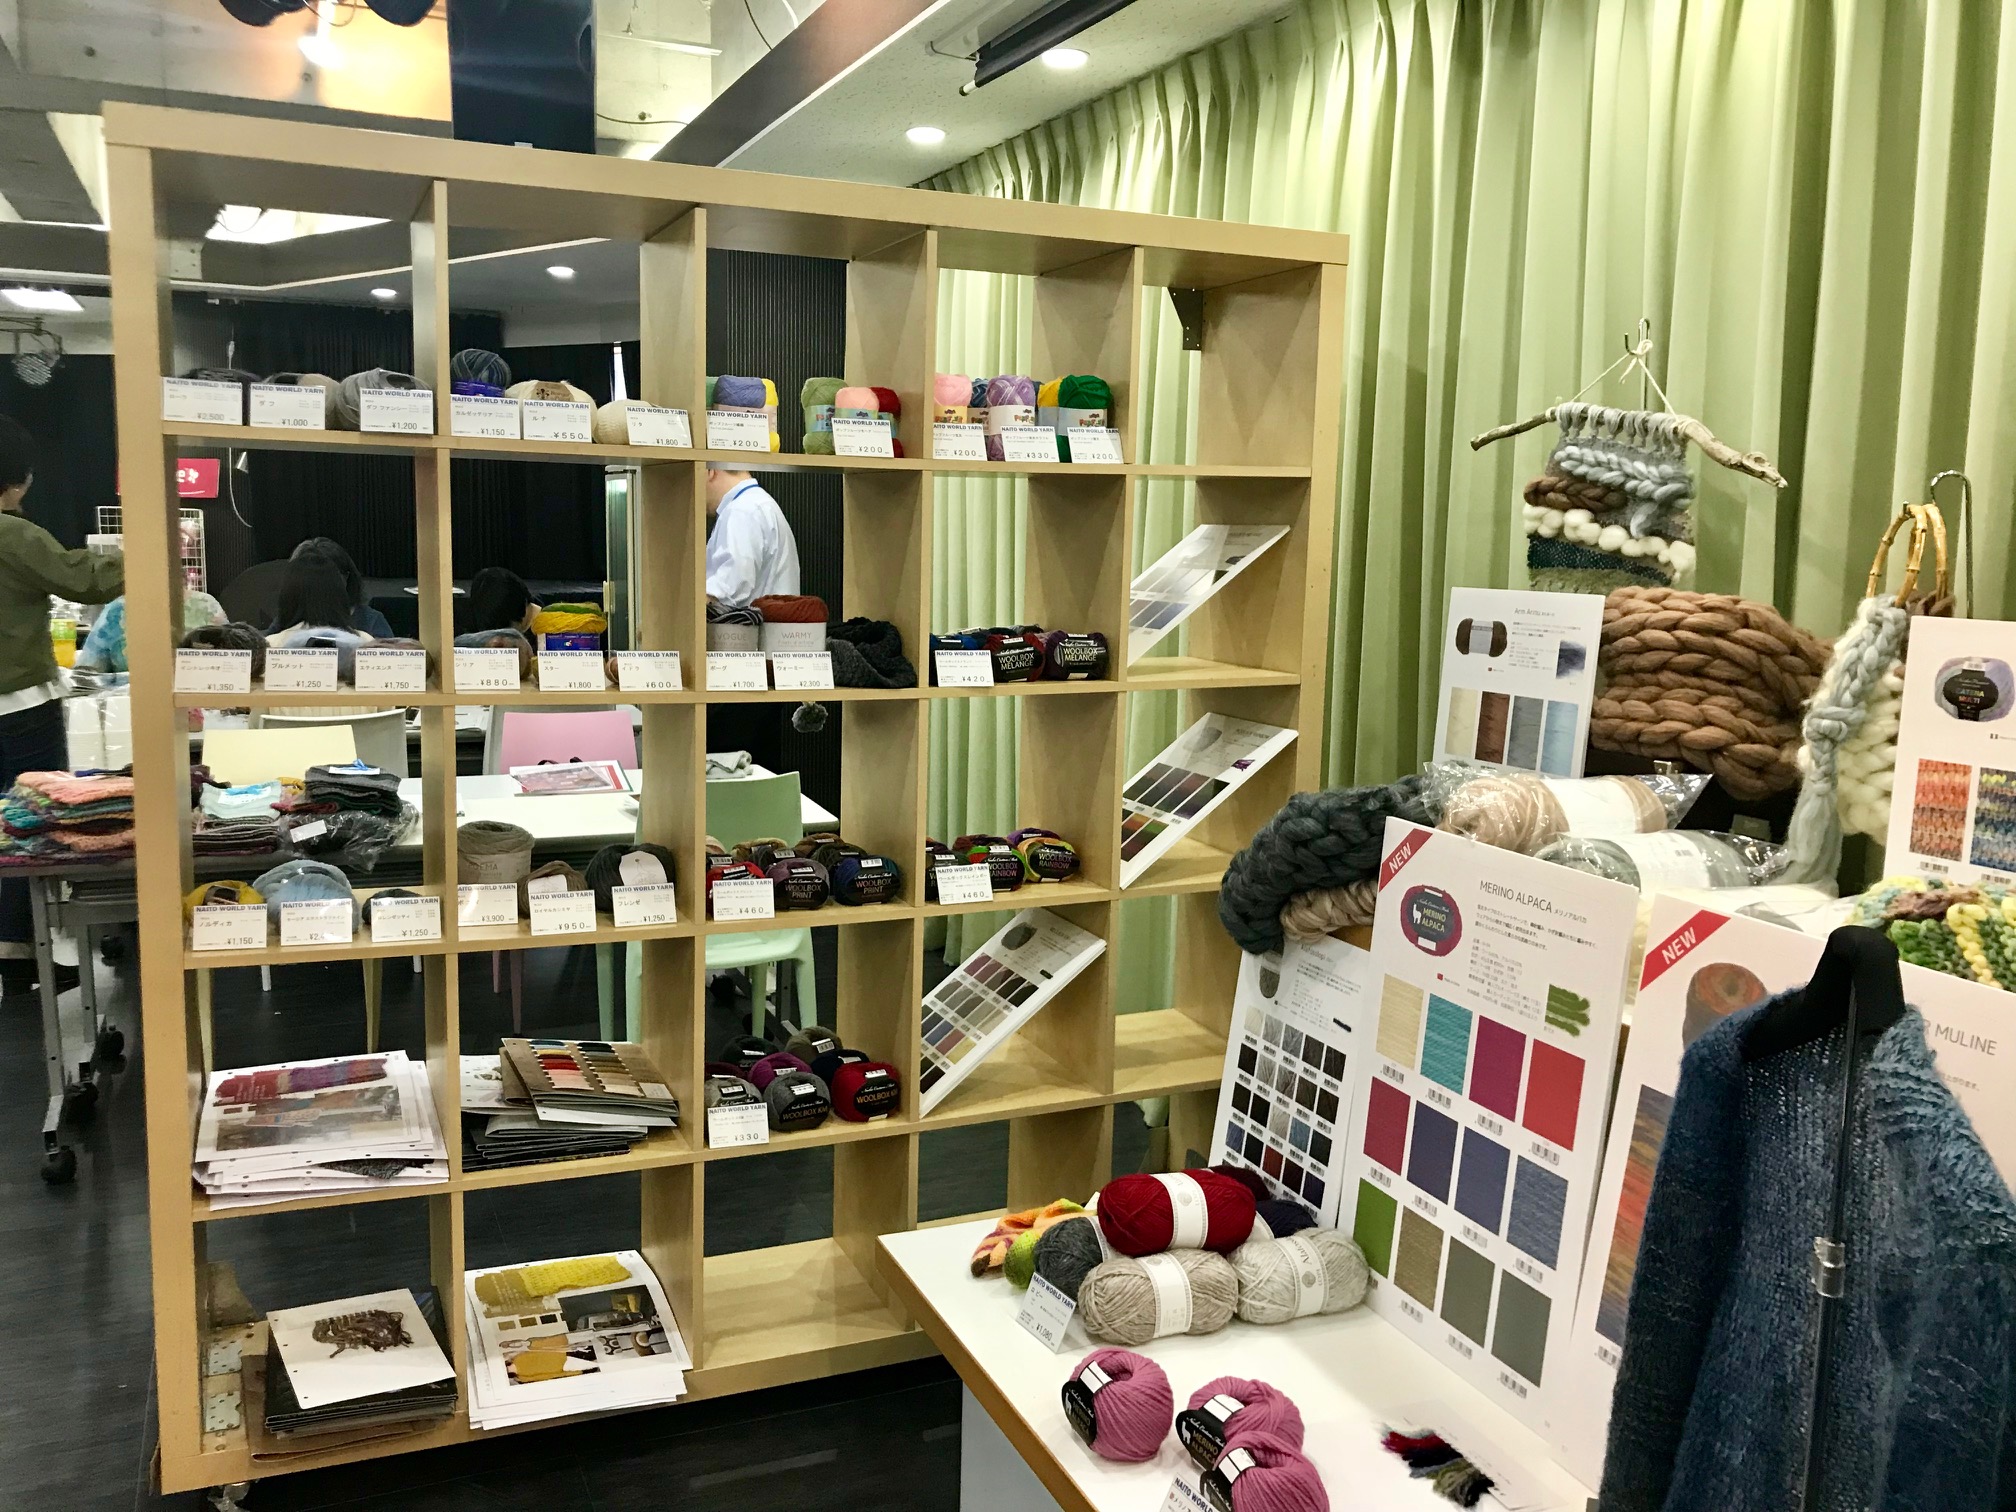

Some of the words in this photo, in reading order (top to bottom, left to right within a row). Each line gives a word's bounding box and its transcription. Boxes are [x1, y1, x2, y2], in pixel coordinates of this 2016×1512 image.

[716, 633, 747, 641] VOGUE
[1063, 647, 1098, 655] WOOLBOX
[998, 652, 1035, 664] WOOLBOX
[1001, 659, 1034, 671] MELANGE
[1039, 853, 1072, 863] WOOLBOX
[1388, 842, 1412, 874] NEW
[1039, 860, 1070, 869] RAINBOW
[633, 884, 656, 892] WORLD
[656, 883, 673, 891] YARN
[785, 884, 822, 892] WOOLBOX
[855, 878, 892, 888] WOOLBOX
[863, 886, 884, 894] PRINT
[1479, 880, 1514, 901] MERINO
[1515, 892, 1552, 913] ALPACA
[1423, 908, 1446, 922] MERINO
[1554, 909, 1587, 924] メリノアルパカ
[1422, 917, 1445, 932] ALPACA
[1661, 926, 1697, 964] NEW
[1934, 1023, 1997, 1056] MULINE
[856, 1090, 891, 1104] WOOLBOX
[727, 1105, 749, 1113] WORLD
[782, 1108, 817, 1120] WOOLBOX
[1033, 1274, 1046, 1288] NAITO
[1045, 1282, 1062, 1300] WORLD
[1061, 1297, 1074, 1310] YARN
[1174, 1477, 1192, 1496] NAITO
